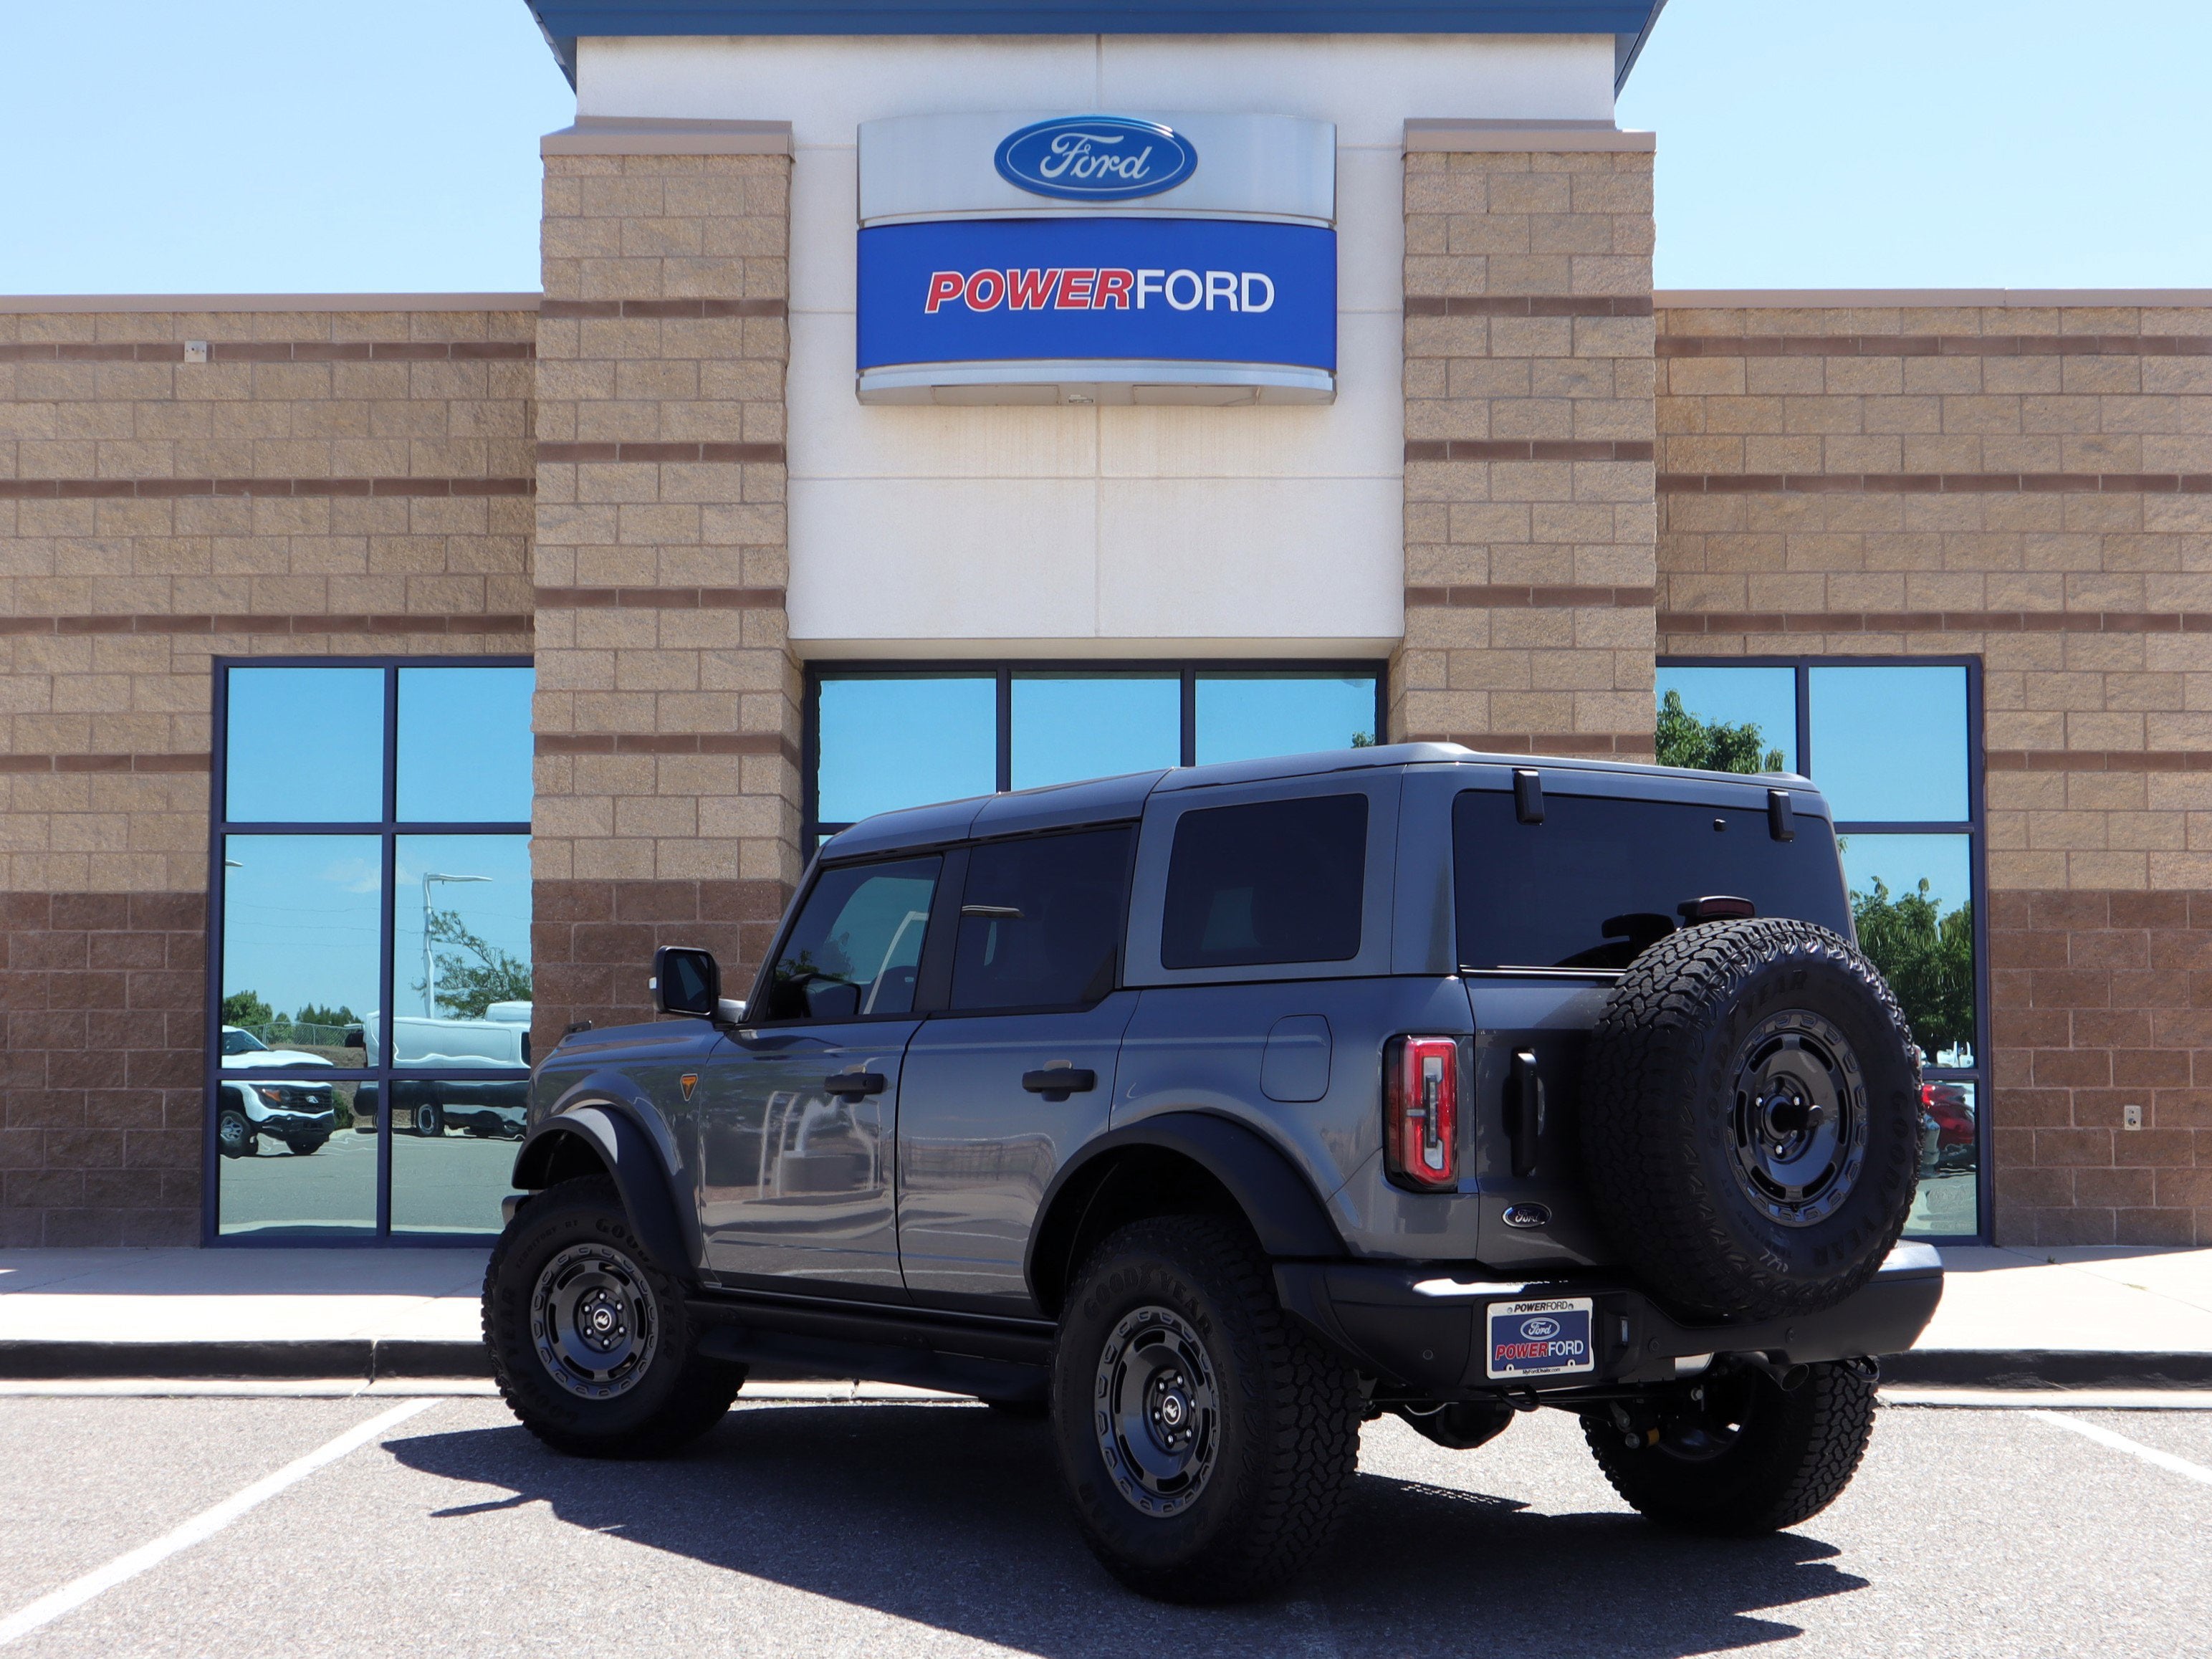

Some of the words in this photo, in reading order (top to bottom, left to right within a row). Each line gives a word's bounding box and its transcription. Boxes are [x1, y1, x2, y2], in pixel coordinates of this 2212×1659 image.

[1039, 132, 1150, 181] Ford
[1515, 1209, 1541, 1223] Ford
[1528, 1321, 1552, 1336] Ford
